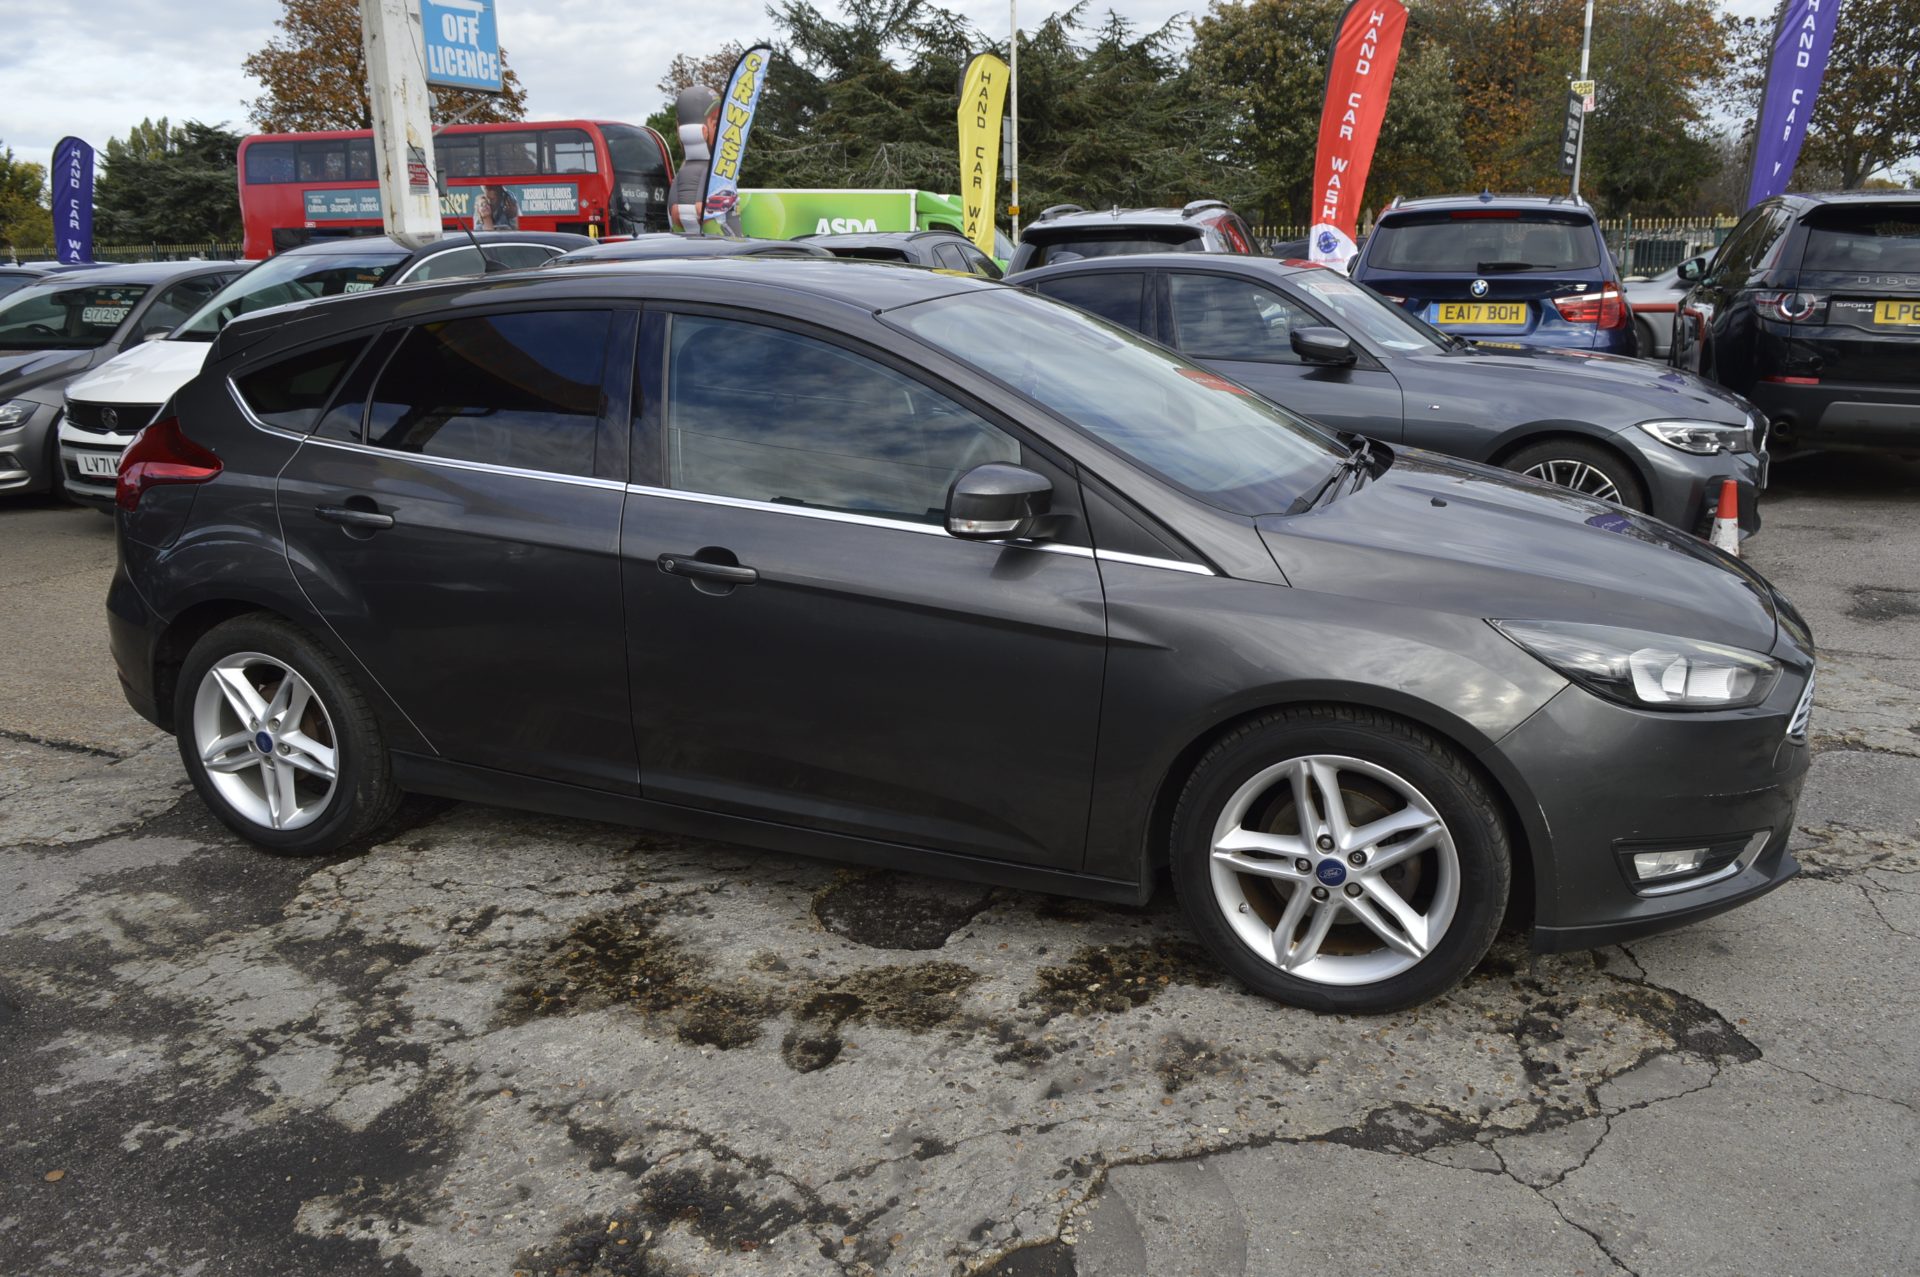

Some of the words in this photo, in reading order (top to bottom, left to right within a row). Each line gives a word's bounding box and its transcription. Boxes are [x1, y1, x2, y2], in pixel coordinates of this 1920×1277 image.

[442, 13, 480, 46] OFF
[1356, 10, 1384, 76] HAND
[1796, 0, 1820, 68] HAND
[427, 44, 499, 81] LICENCE
[732, 52, 763, 106] CAR
[976, 70, 992, 129] HAND
[1339, 92, 1362, 141] CAR
[1783, 89, 1804, 142] CAR
[714, 102, 751, 180] WASH
[70, 149, 80, 188] HAND
[972, 146, 985, 190] CAR
[1322, 156, 1349, 220] WASH
[69, 199, 80, 230] CAR
[654, 187, 665, 201] 62
[815, 217, 878, 235] ASDA
[1445, 305, 1482, 321] EA17
[1487, 305, 1520, 321] BOH
